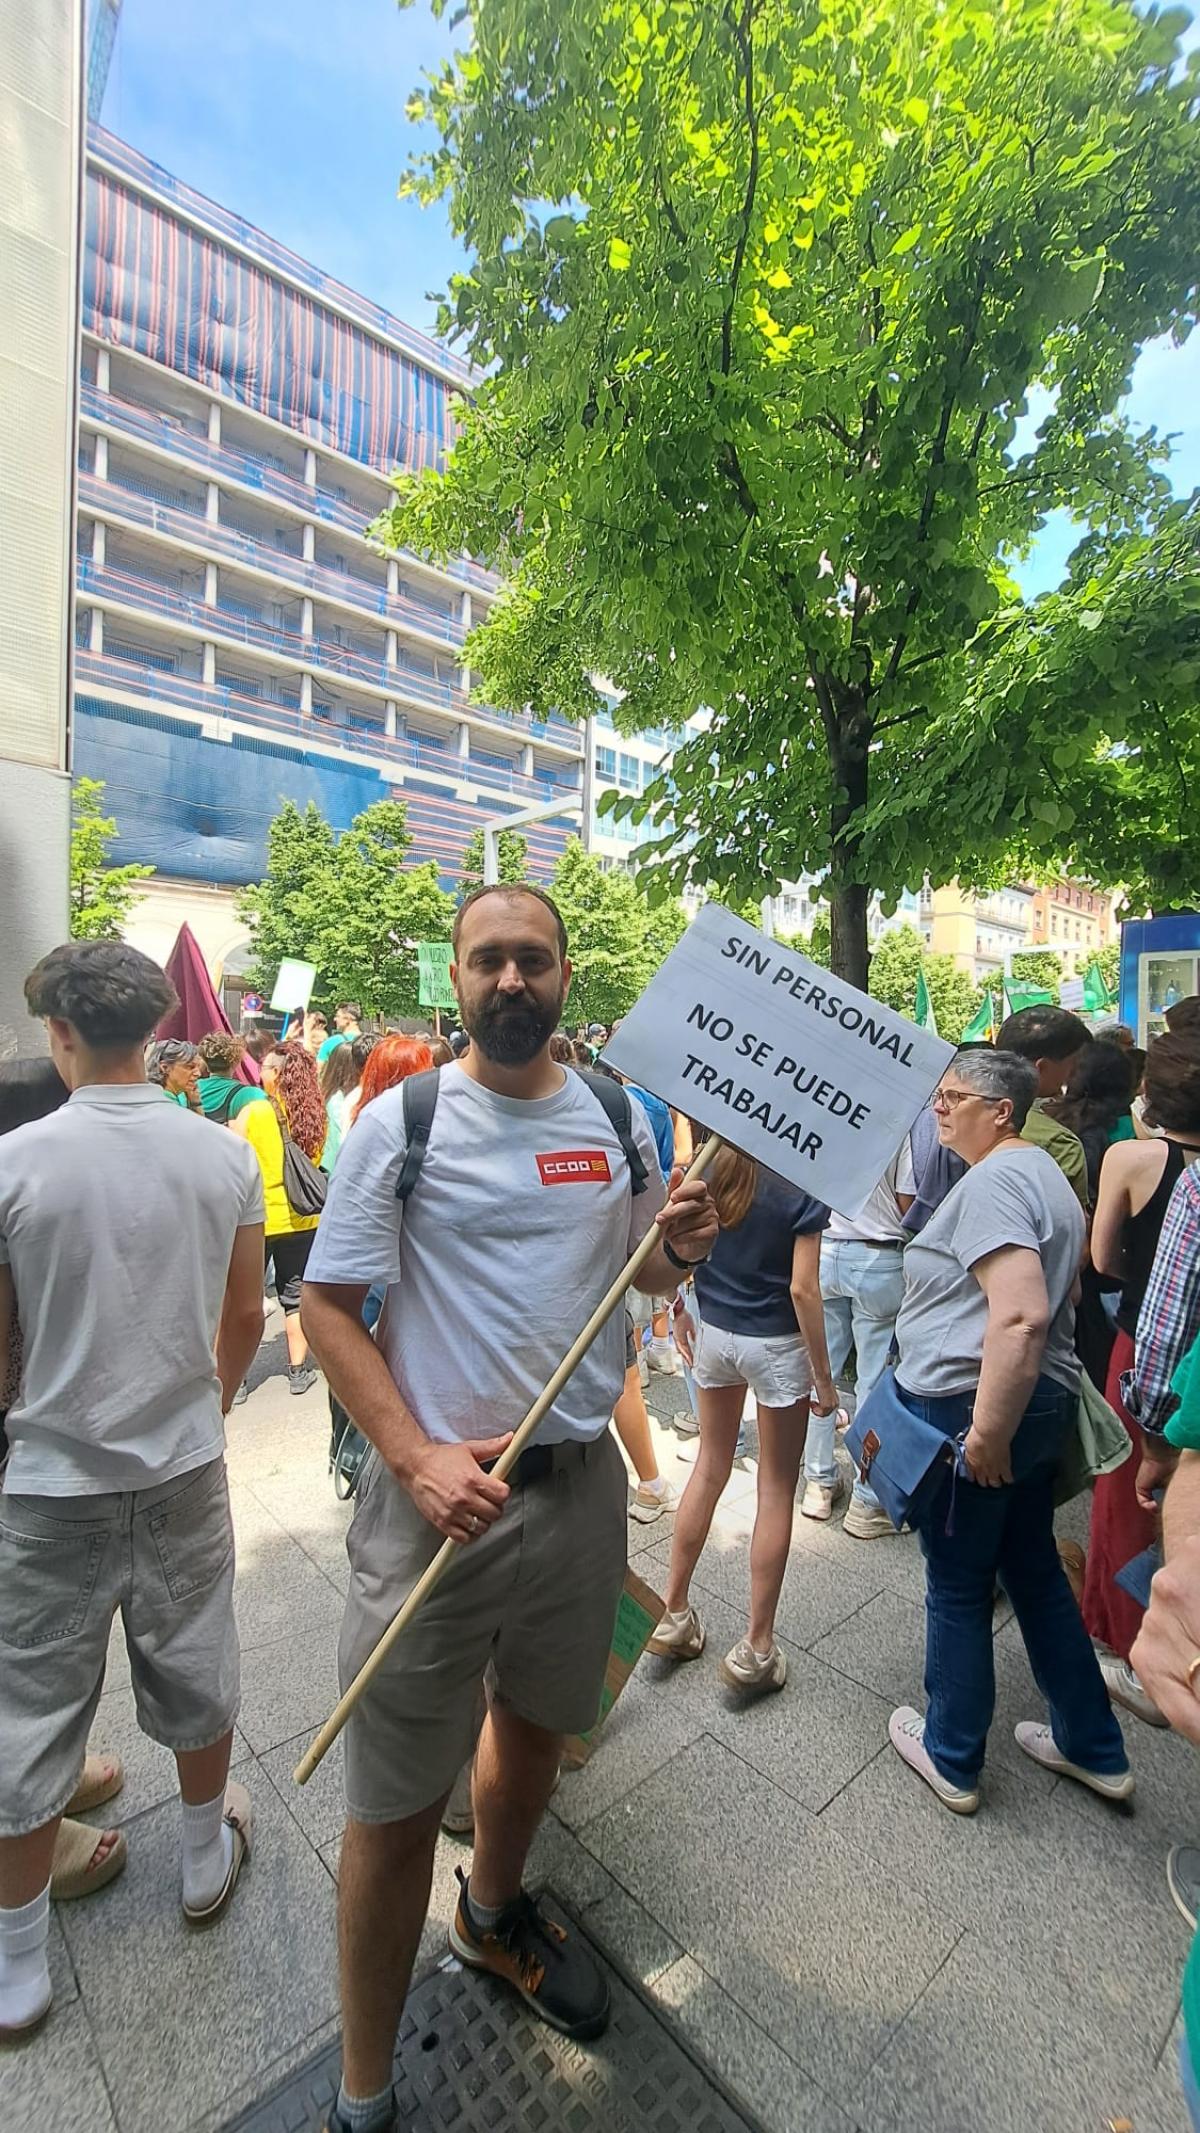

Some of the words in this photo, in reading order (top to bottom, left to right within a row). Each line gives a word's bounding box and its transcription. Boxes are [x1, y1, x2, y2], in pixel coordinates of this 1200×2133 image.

[721, 936, 771, 975] SIN
[772, 965, 915, 1068] PERSONAL
[680, 1054, 823, 1160] TRABAJAR
[686, 1003, 734, 1042] NO
[735, 1033, 774, 1067] SE
[773, 1056, 871, 1130] PUEDE
[543, 1160, 591, 1174] CCOO
